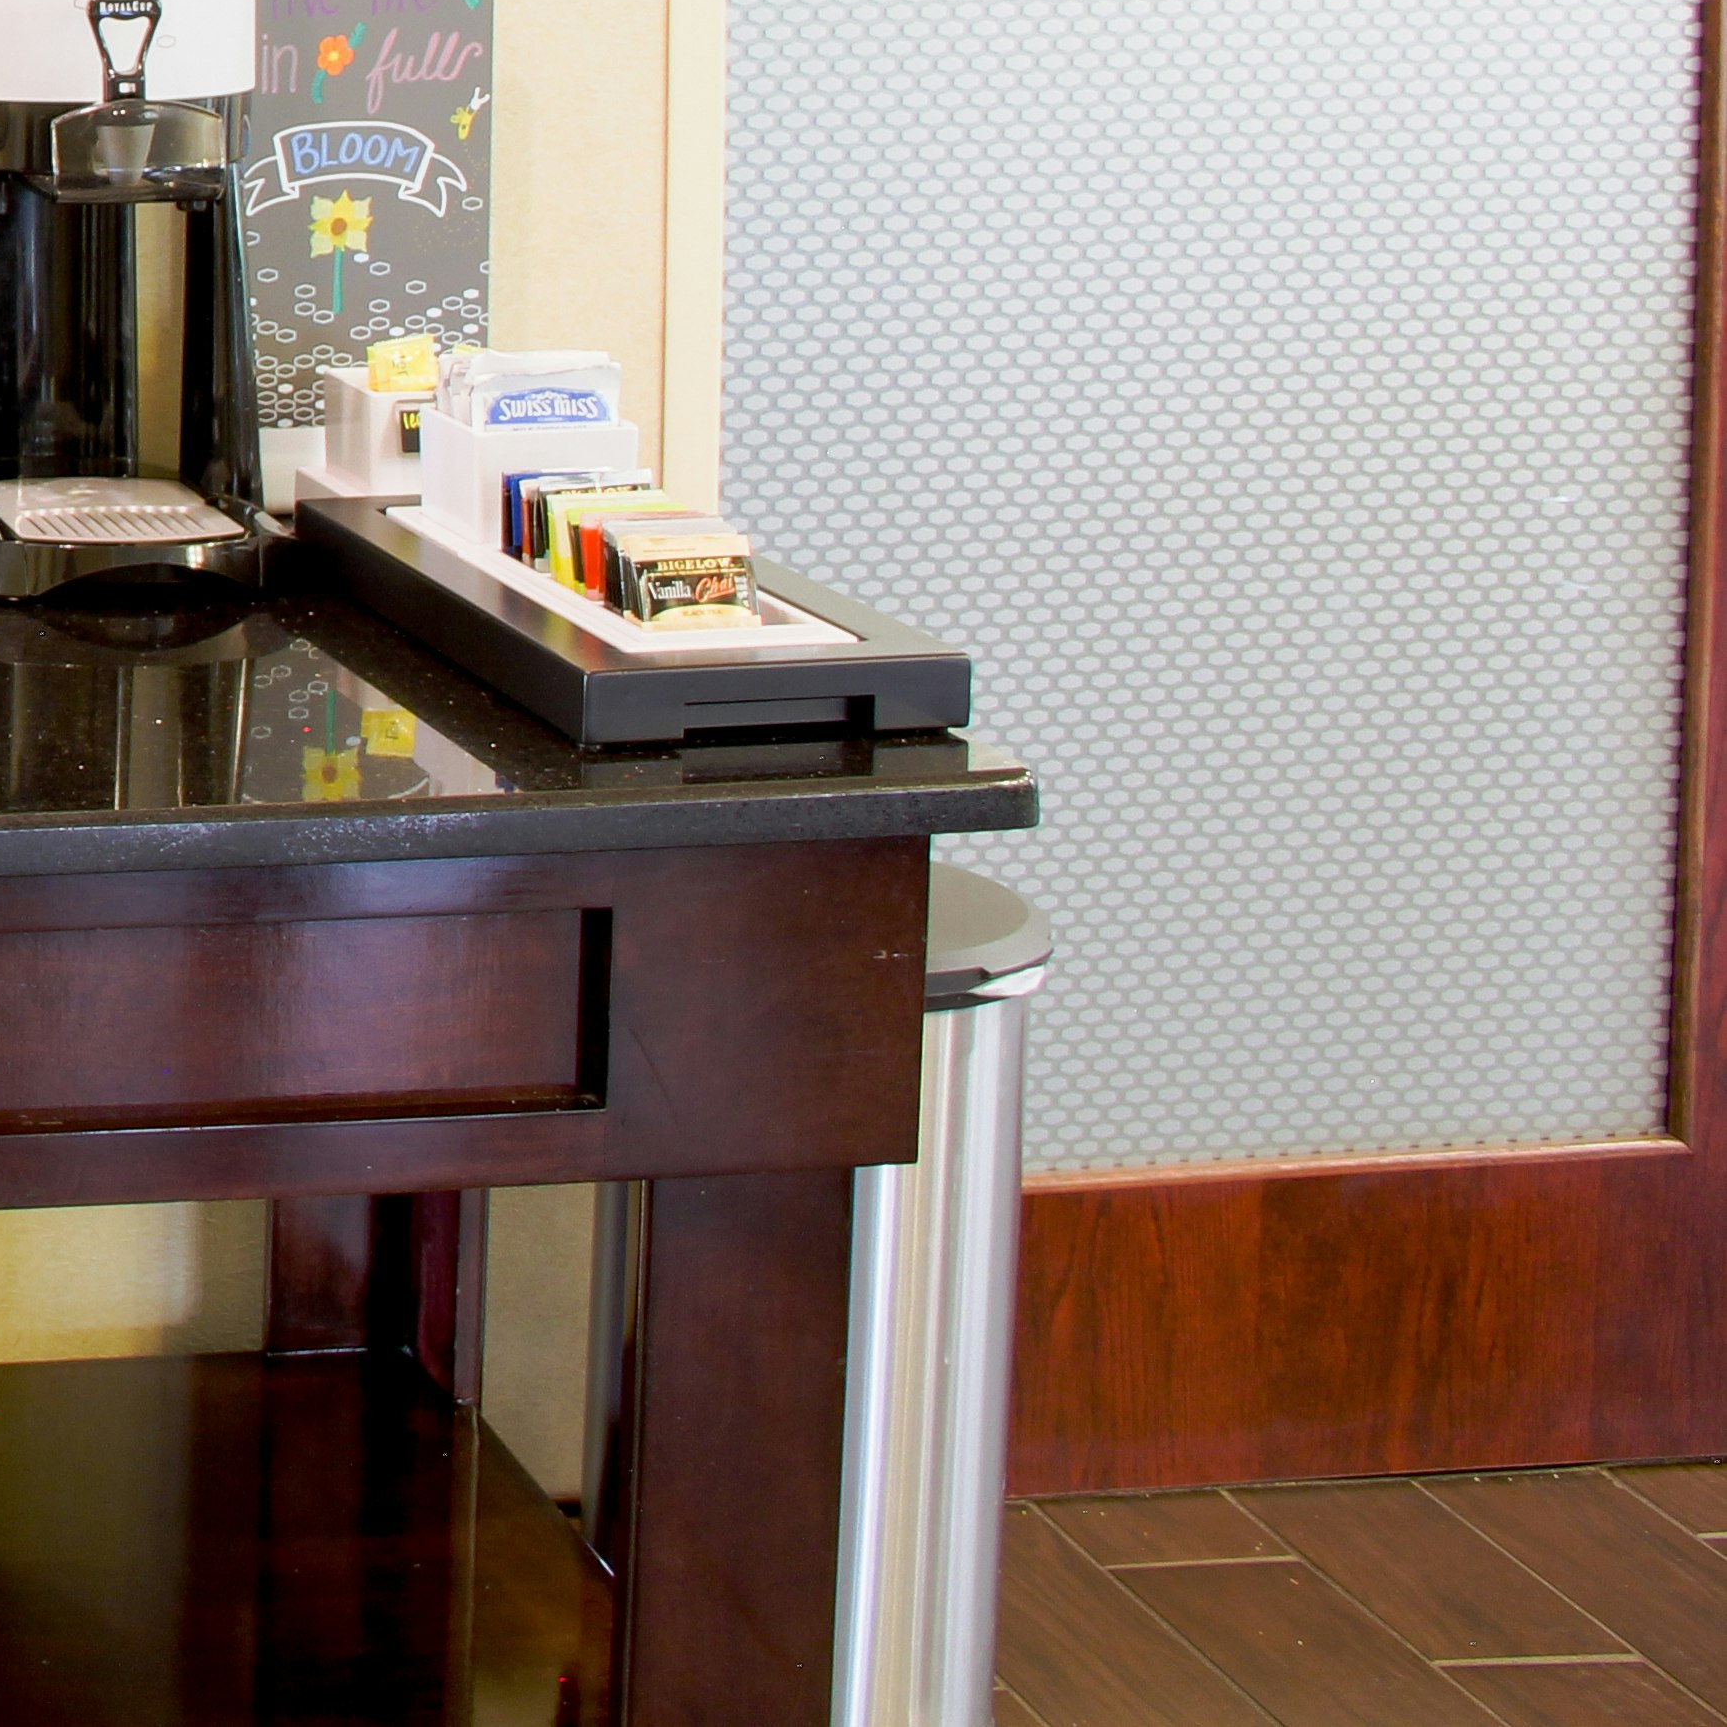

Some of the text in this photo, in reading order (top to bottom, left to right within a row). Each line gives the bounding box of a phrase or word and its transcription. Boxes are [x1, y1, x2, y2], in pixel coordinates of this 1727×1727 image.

[261, 28, 483, 114] in full
[290, 131, 420, 175] BLOOM
[648, 580, 693, 600] Vanilla
[695, 573, 736, 603] Chai
